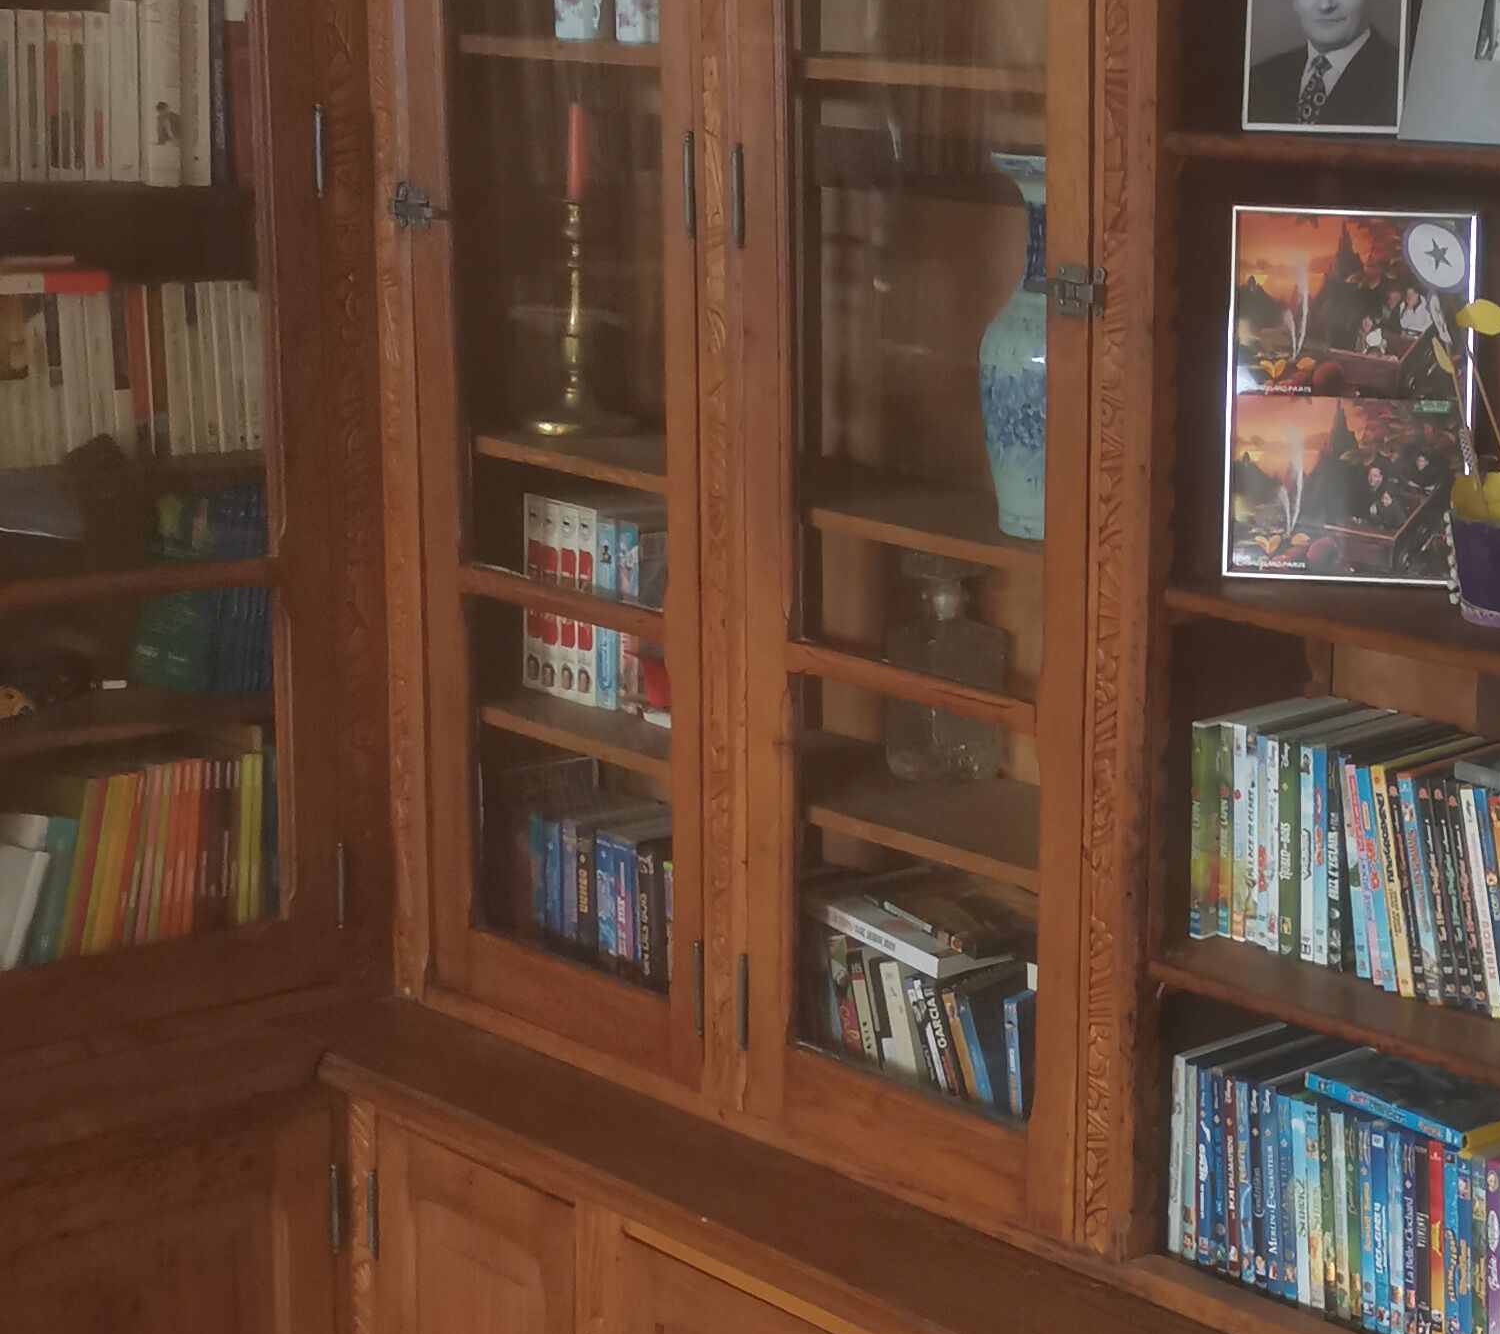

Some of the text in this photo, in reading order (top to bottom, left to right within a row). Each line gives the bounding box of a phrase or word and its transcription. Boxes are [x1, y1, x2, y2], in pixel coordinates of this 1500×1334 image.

[1281, 742, 1291, 768] Disney
[1192, 800, 1201, 827] LAPIN
[1219, 799, 1228, 826] LAPIN
[1481, 921, 1497, 980] KIRIKOU
[926, 998, 948, 1049] GARCIA
[1224, 1078, 1234, 1105] Disney
[1249, 1089, 1259, 1115] Disney
[1262, 1089, 1272, 1115] Disney
[1226, 1134, 1236, 1189] DALMATIENS
[1228, 1189, 1237, 1210] 101
[1252, 1167, 1265, 1219] Cendrillon
[1267, 1214, 1279, 1256] MERLIN
[1402, 1197, 1415, 1285] La Belle Clochard
